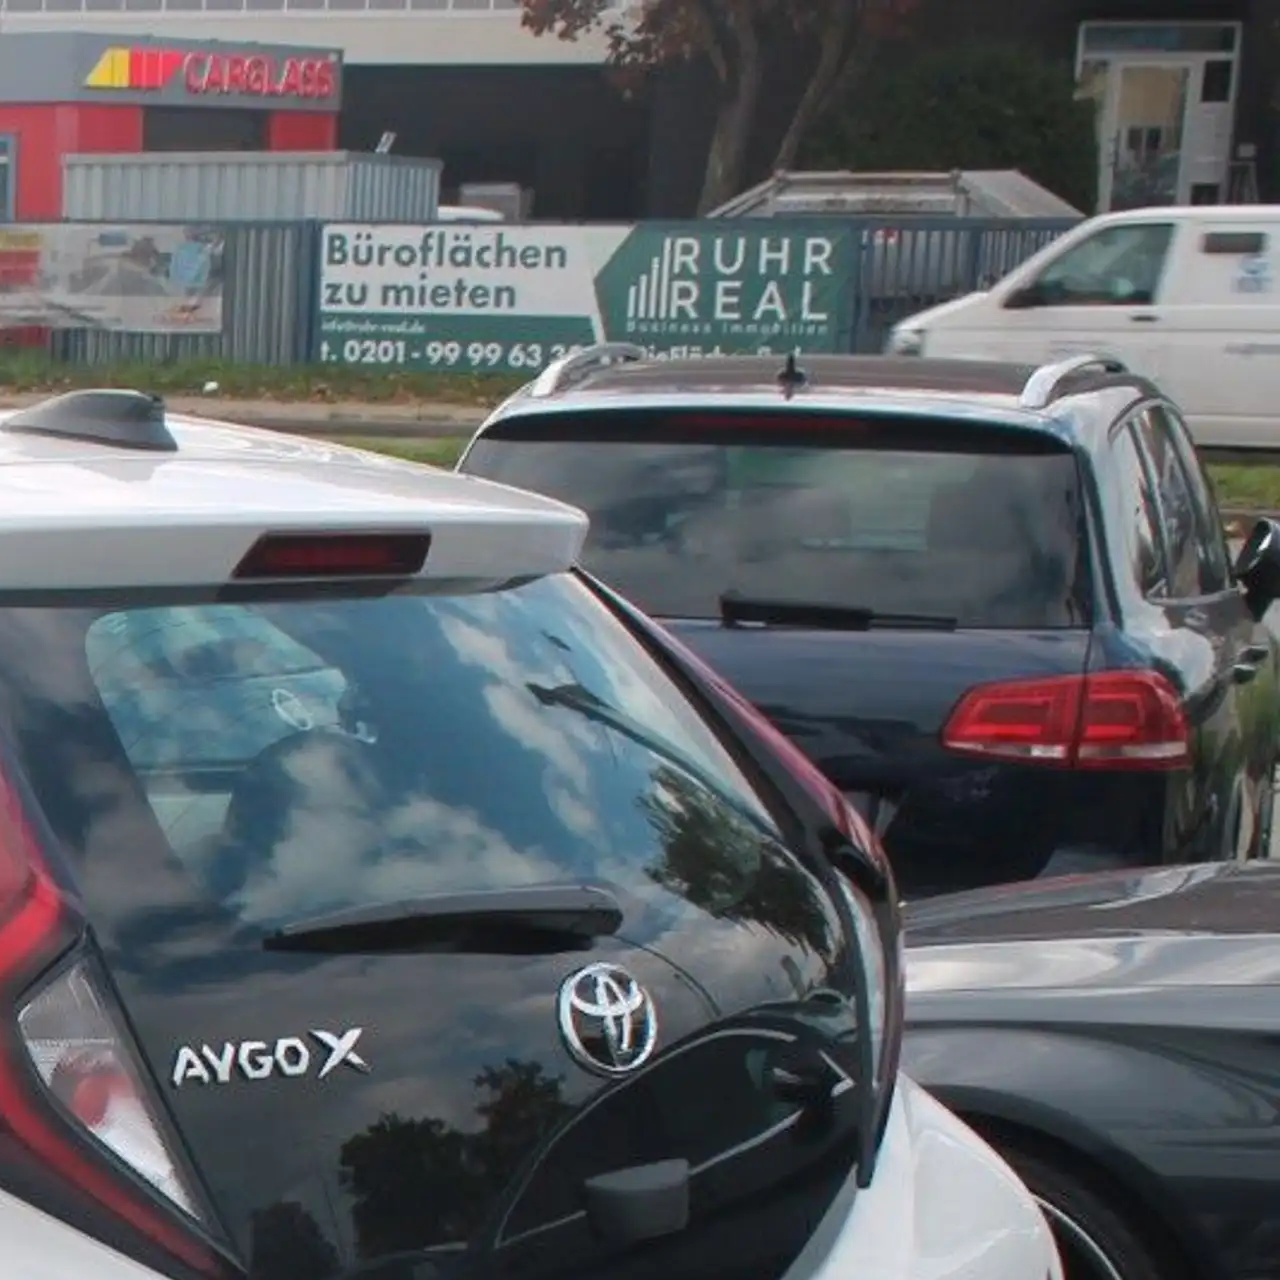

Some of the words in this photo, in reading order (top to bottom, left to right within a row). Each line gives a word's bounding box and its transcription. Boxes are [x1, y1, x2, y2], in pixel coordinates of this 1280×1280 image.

[183, 52, 335, 98] CARGLASS
[325, 232, 567, 269] Büroflächen
[672, 236, 834, 275] RUHR
[324, 282, 368, 306] zu
[380, 272, 517, 308] mieten
[669, 279, 830, 321] REAL
[626, 320, 713, 334] Business
[320, 340, 338, 362] t.
[343, 340, 407, 364] 0201
[425, 342, 462, 366] 99
[466, 342, 503, 367] 99
[507, 343, 543, 368] 63
[172, 1036, 310, 1087] AYGO
[307, 1026, 372, 1080] X
